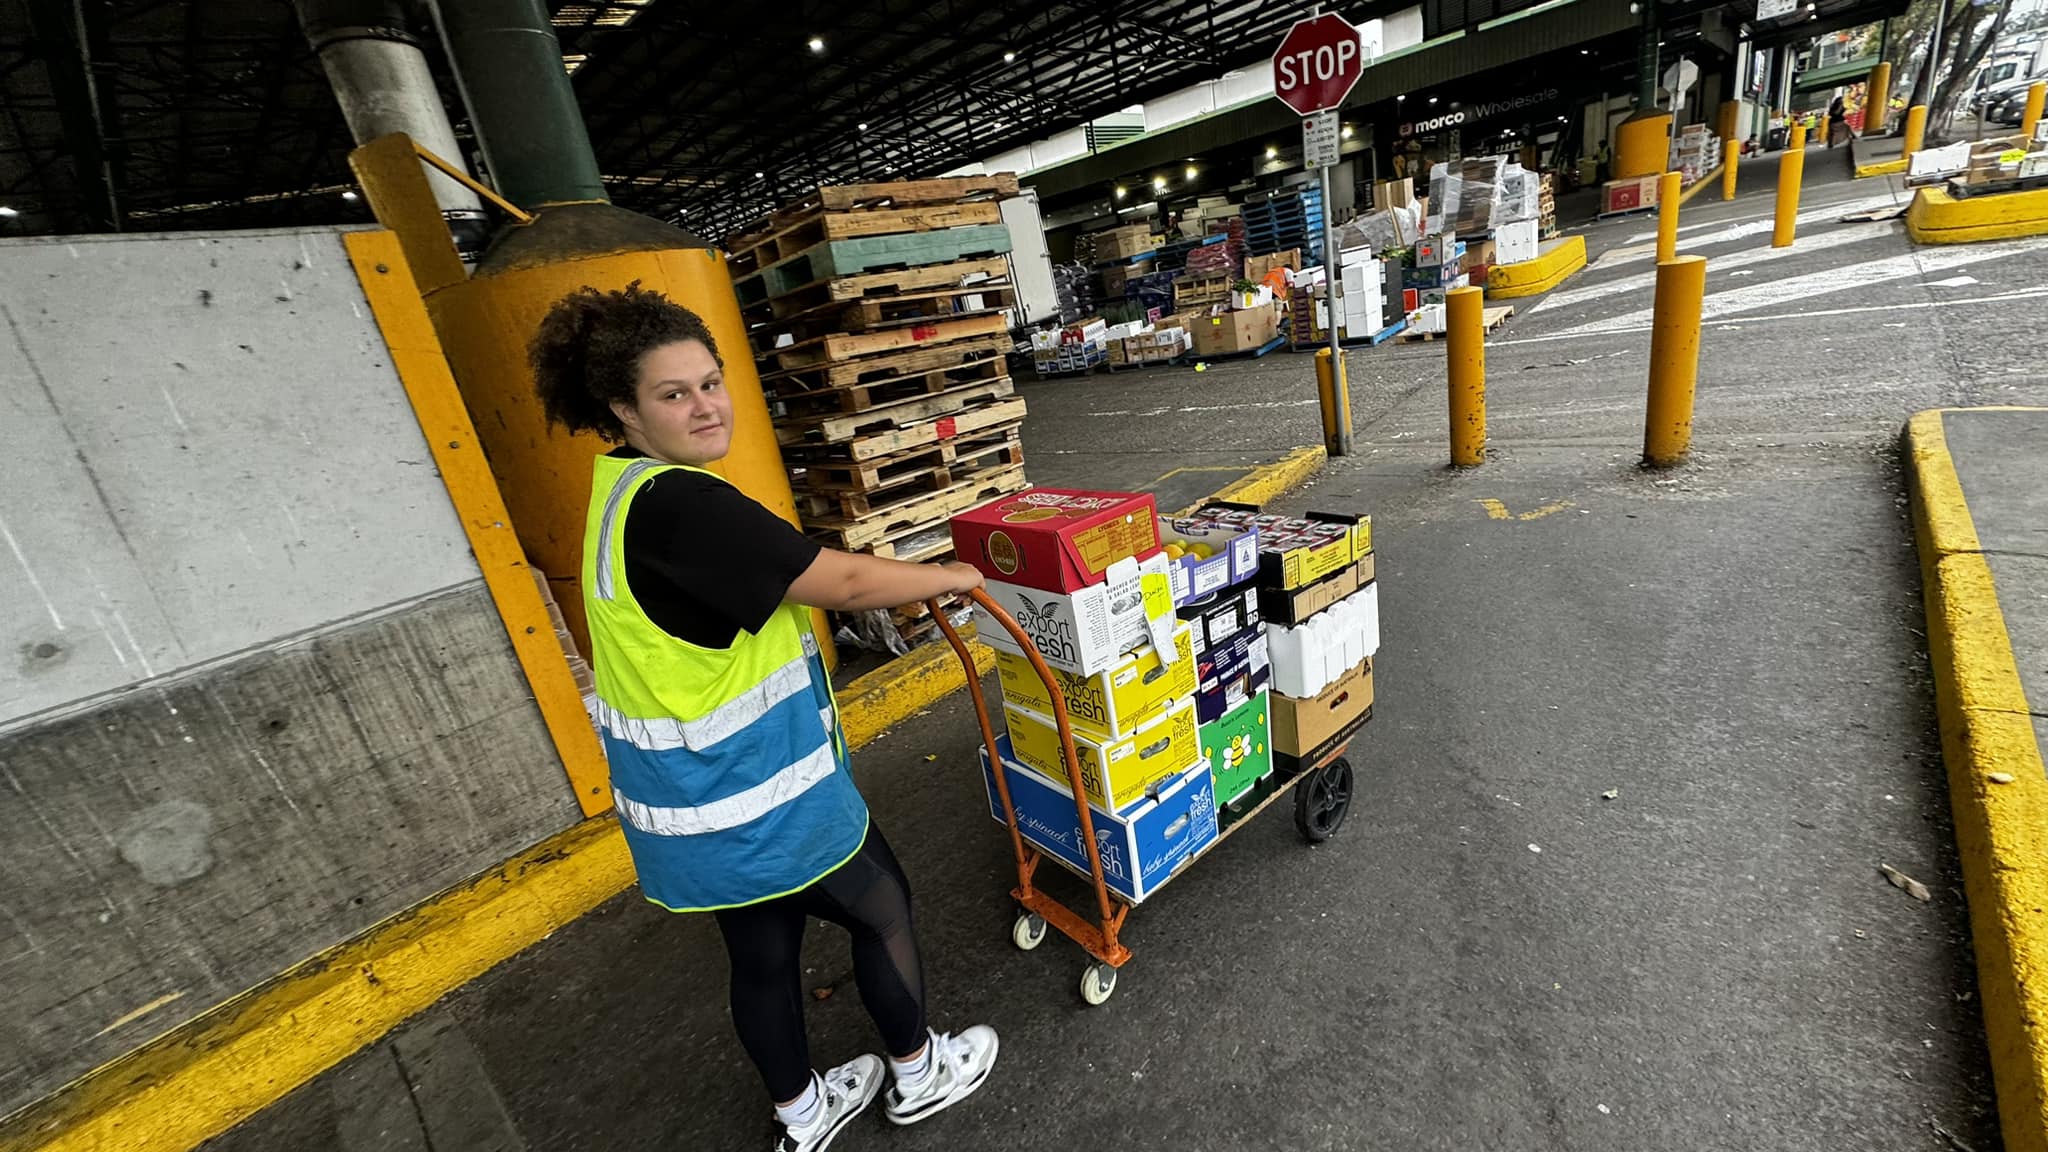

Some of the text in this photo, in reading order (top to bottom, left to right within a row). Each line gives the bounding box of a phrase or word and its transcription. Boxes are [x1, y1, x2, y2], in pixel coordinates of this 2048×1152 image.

[1279, 39, 1356, 91] STOP
[1415, 87, 1559, 134] morco Wholesale
[1017, 610, 1072, 640] export
[1027, 631, 1077, 663] resh
[1064, 695, 1106, 722] resh
[1173, 722, 1195, 741] fresh
[1190, 799, 1213, 821] fresh
[1027, 817, 1070, 843] spinach
